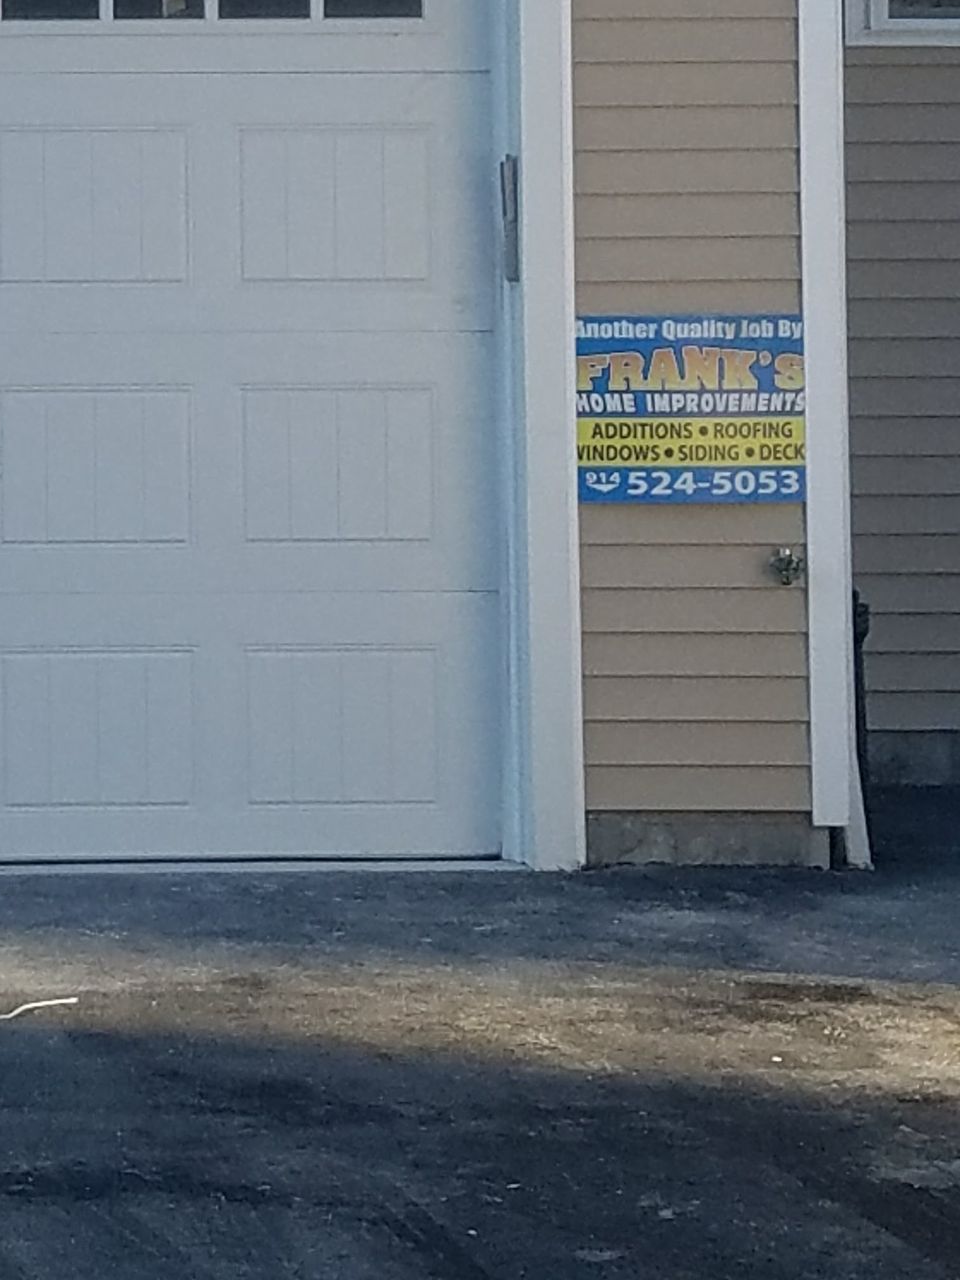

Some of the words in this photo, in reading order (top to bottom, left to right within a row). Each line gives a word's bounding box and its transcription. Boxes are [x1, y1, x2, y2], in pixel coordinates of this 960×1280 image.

[576, 320, 656, 338] Another
[662, 320, 735, 339] Quality
[740, 320, 773, 337] Job
[778, 320, 802, 339] By
[577, 346, 804, 391] FRANK'S
[577, 393, 636, 412] HOME
[647, 392, 804, 412] IMPROVEMENTS
[591, 422, 693, 439] ADDITIONS
[713, 422, 793, 438] ROOFING
[678, 444, 739, 460] SIDING
[586, 472, 620, 484] 914
[627, 471, 799, 495] 524-5053
